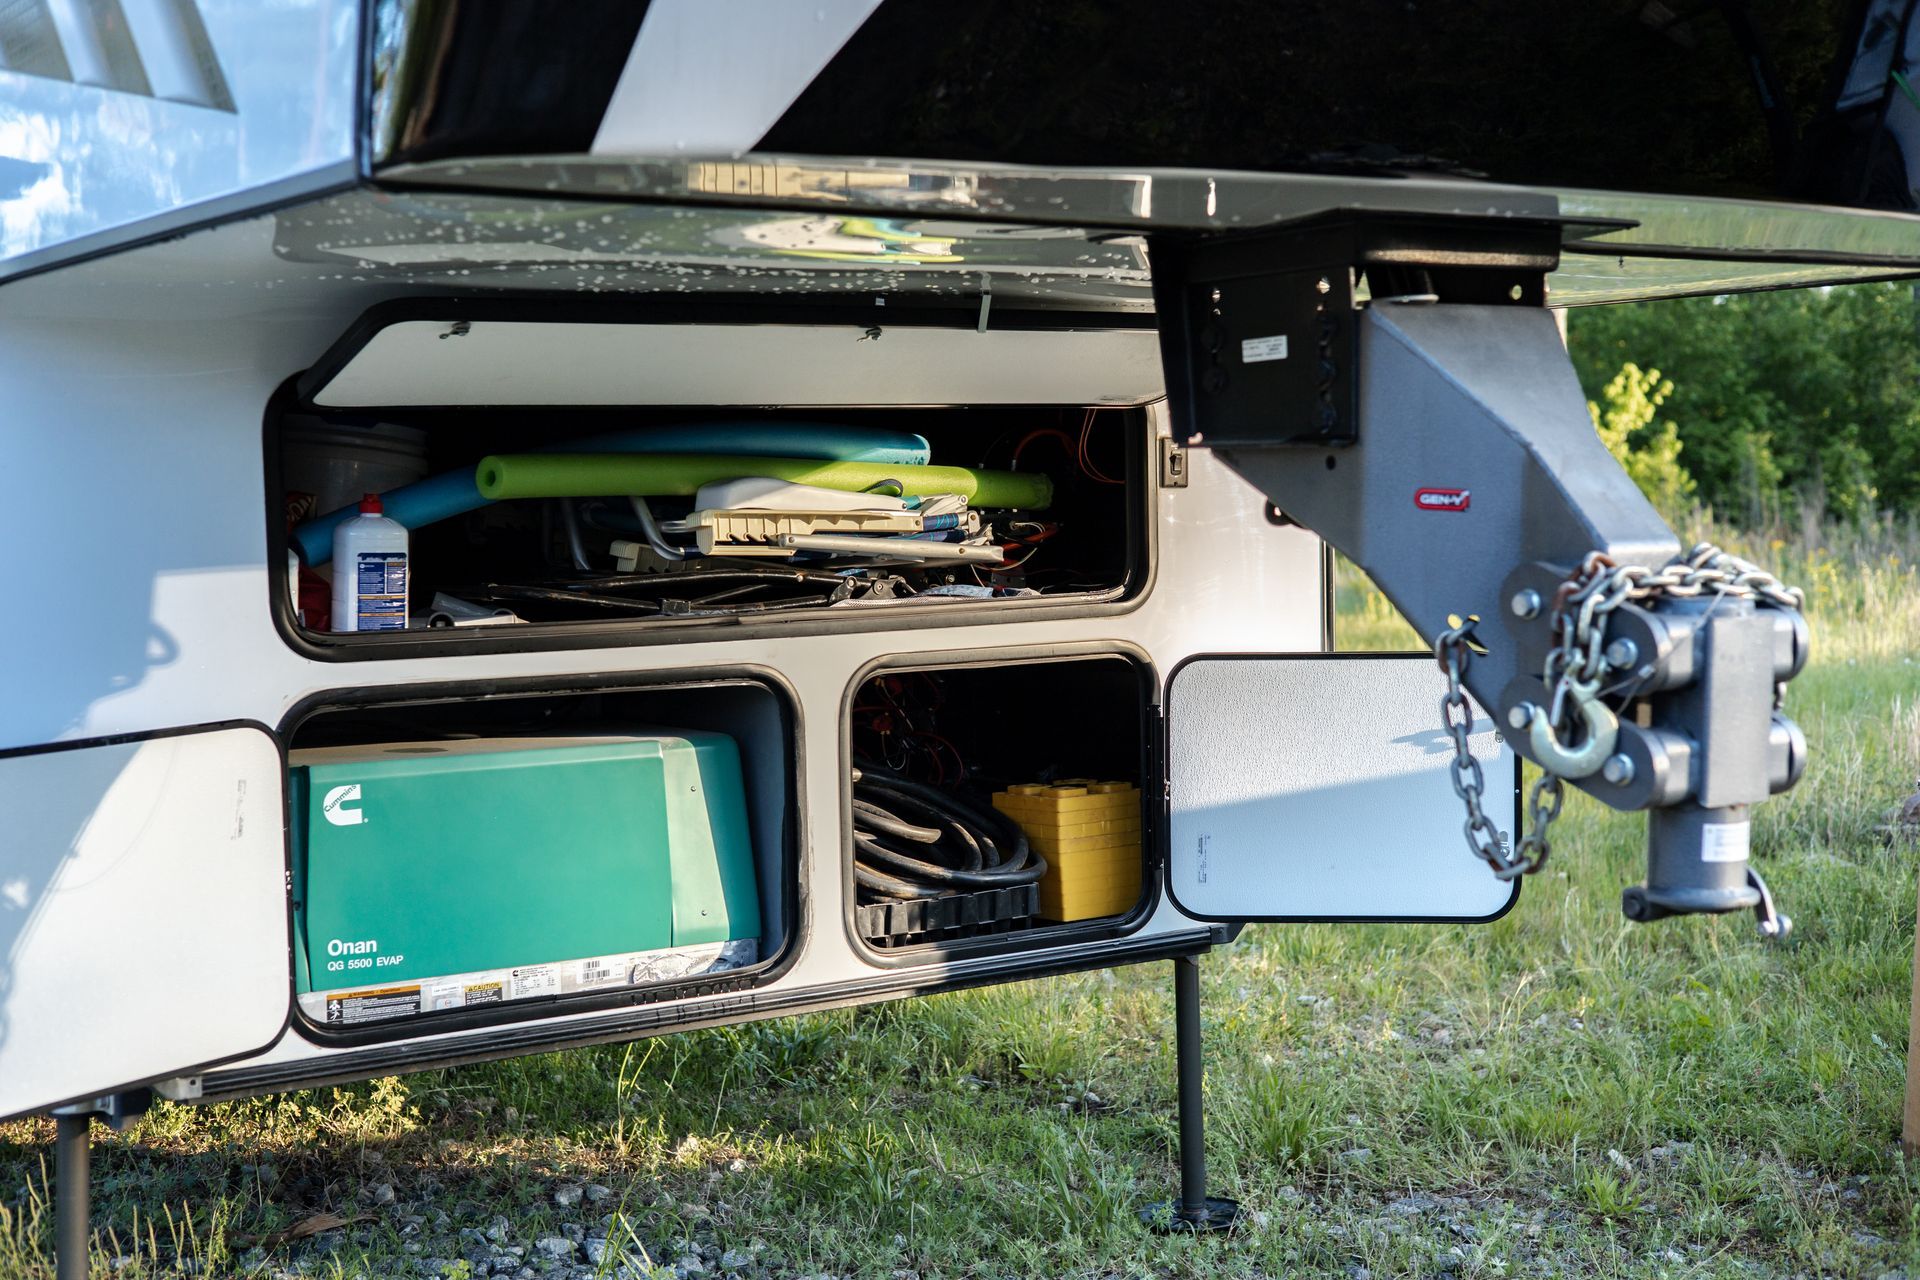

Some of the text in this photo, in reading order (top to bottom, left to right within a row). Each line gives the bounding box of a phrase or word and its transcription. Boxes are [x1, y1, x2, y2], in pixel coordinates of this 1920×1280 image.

[323, 784, 358, 813] Cummins
[327, 939, 377, 957] Onan
[327, 955, 404, 972] QG 5500 EVAP
[473, 982, 500, 991] CAUTION
